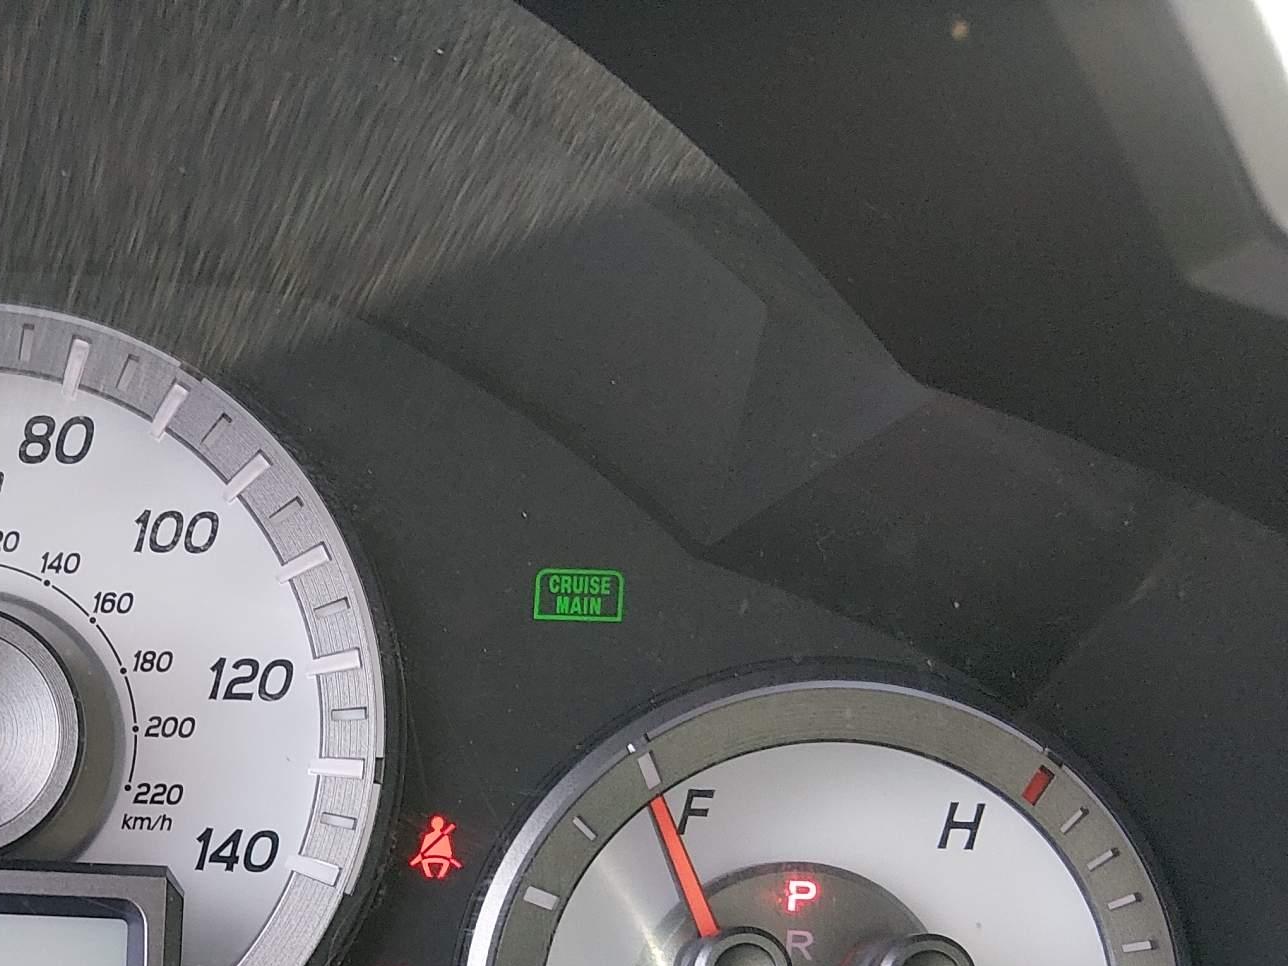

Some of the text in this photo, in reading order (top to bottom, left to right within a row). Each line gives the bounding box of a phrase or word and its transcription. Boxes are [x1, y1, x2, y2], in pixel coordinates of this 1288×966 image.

[19, 415, 94, 464] 80
[134, 510, 219, 553] 100
[41, 552, 80, 574] 140
[549, 575, 610, 594] CRUISE
[94, 592, 133, 613] 160
[556, 596, 602, 615] MAIN
[133, 651, 173, 672] 180
[209, 658, 293, 701] 120
[145, 716, 195, 738] 200
[133, 783, 183, 805] 220
[122, 814, 173, 832] km/h
[677, 789, 716, 834] F
[938, 802, 985, 850] H
[195, 828, 279, 872] 140
[787, 880, 817, 911] P
[785, 929, 815, 960] R
